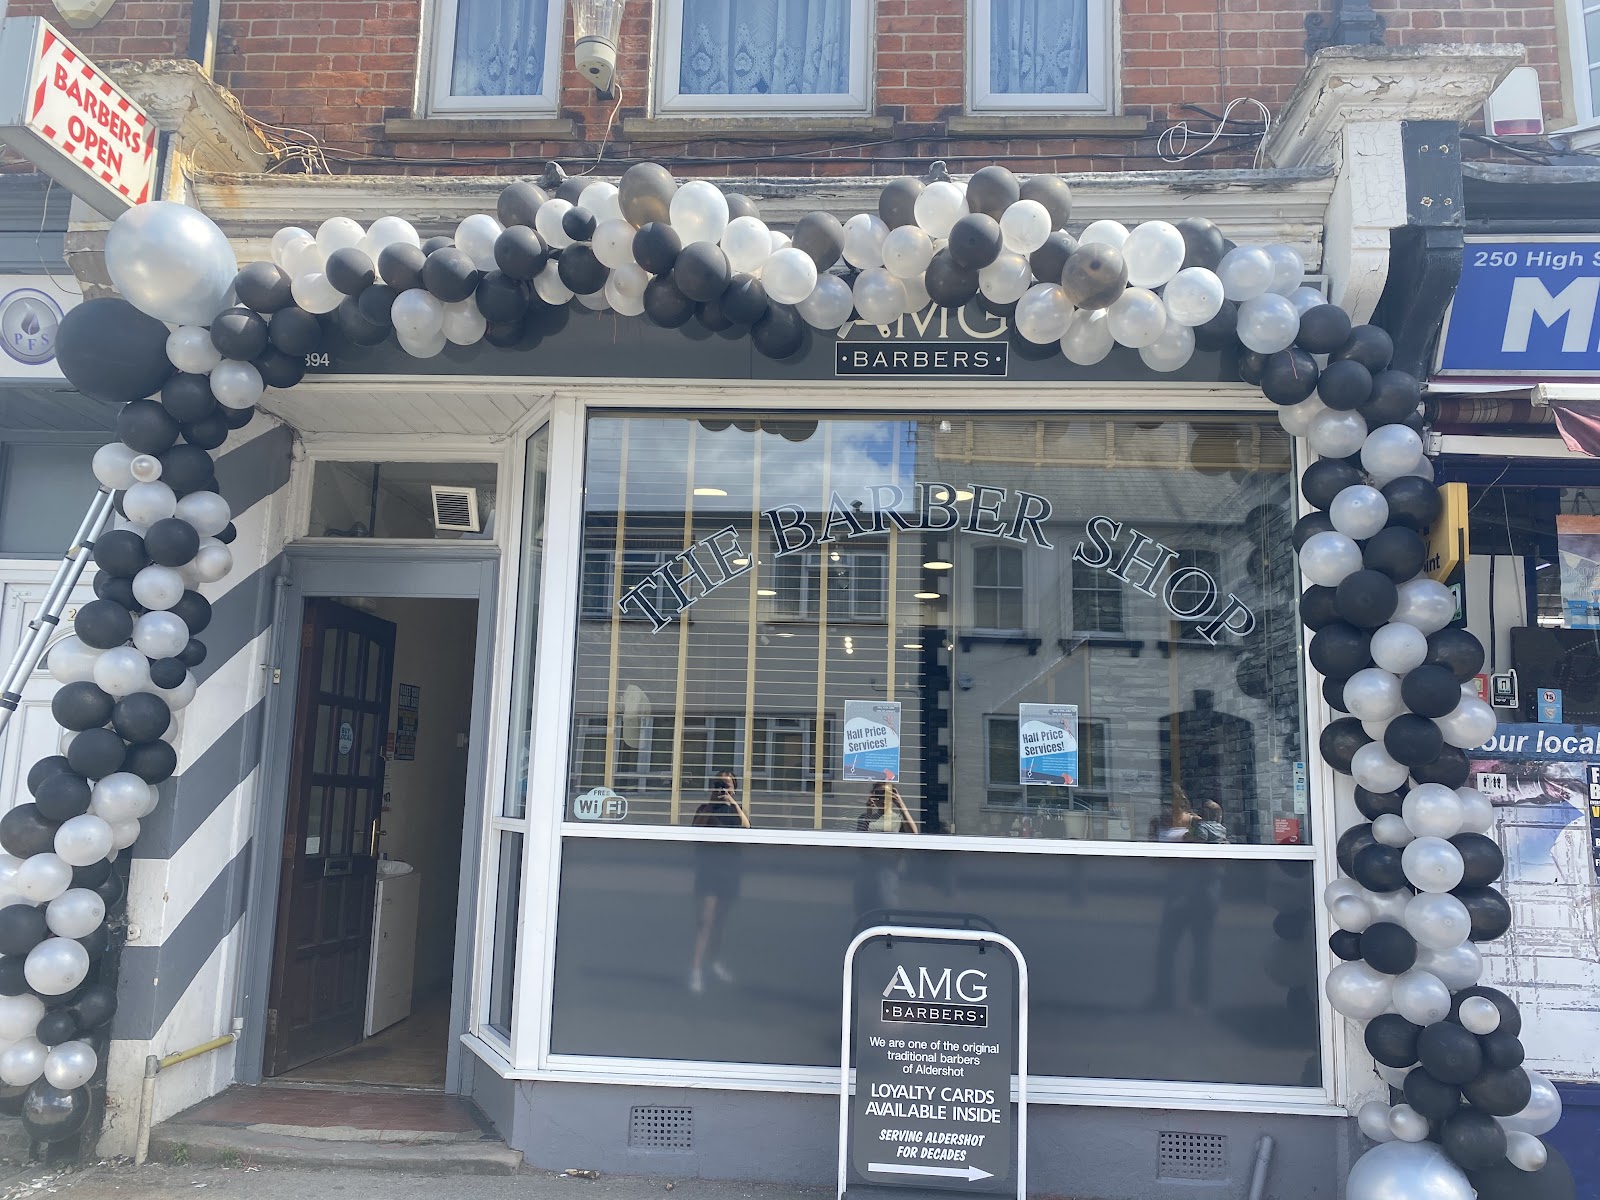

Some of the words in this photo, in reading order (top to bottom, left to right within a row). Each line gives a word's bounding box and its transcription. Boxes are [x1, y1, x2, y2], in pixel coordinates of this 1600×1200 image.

[53, 62, 141, 154] BARBERS
[67, 115, 124, 176] OPEN
[1473, 251, 1518, 267] 250
[1525, 250, 1584, 271] High
[1501, 276, 1600, 353] M
[852, 350, 990, 368] BARBERS
[616, 524, 755, 635] THE
[761, 481, 1055, 559] BARBER
[1071, 515, 1256, 646] SHOP
[846, 729, 863, 740] Half
[864, 726, 887, 738] Price
[1040, 730, 1064, 741] Price
[848, 738, 888, 752] Services!
[1024, 742, 1065, 756] Services!
[1468, 734, 1529, 753] our
[882, 964, 988, 1003] AMG
[892, 1006, 977, 1022] BARBERS
[869, 1036, 886, 1048] We
[888, 1039, 905, 1048] are
[908, 1040, 928, 1049] one
[930, 1039, 941, 1050] of
[943, 1041, 960, 1051] the
[962, 1043, 1000, 1055] original
[887, 1050, 937, 1063] traditional
[940, 1052, 981, 1066] barbers
[902, 1064, 914, 1074] of
[915, 1064, 965, 1077] Aldershot
[871, 1083, 936, 1100] LOYALTY
[940, 1087, 995, 1105] CARDS
[865, 1101, 947, 1120] AVAILABLE
[952, 1106, 1001, 1124] INSIDE
[879, 1128, 923, 1143] SERVING
[924, 1131, 986, 1147] ALDERSHOT
[896, 1145, 918, 1158] FOR
[920, 1147, 967, 1162] DECADES
